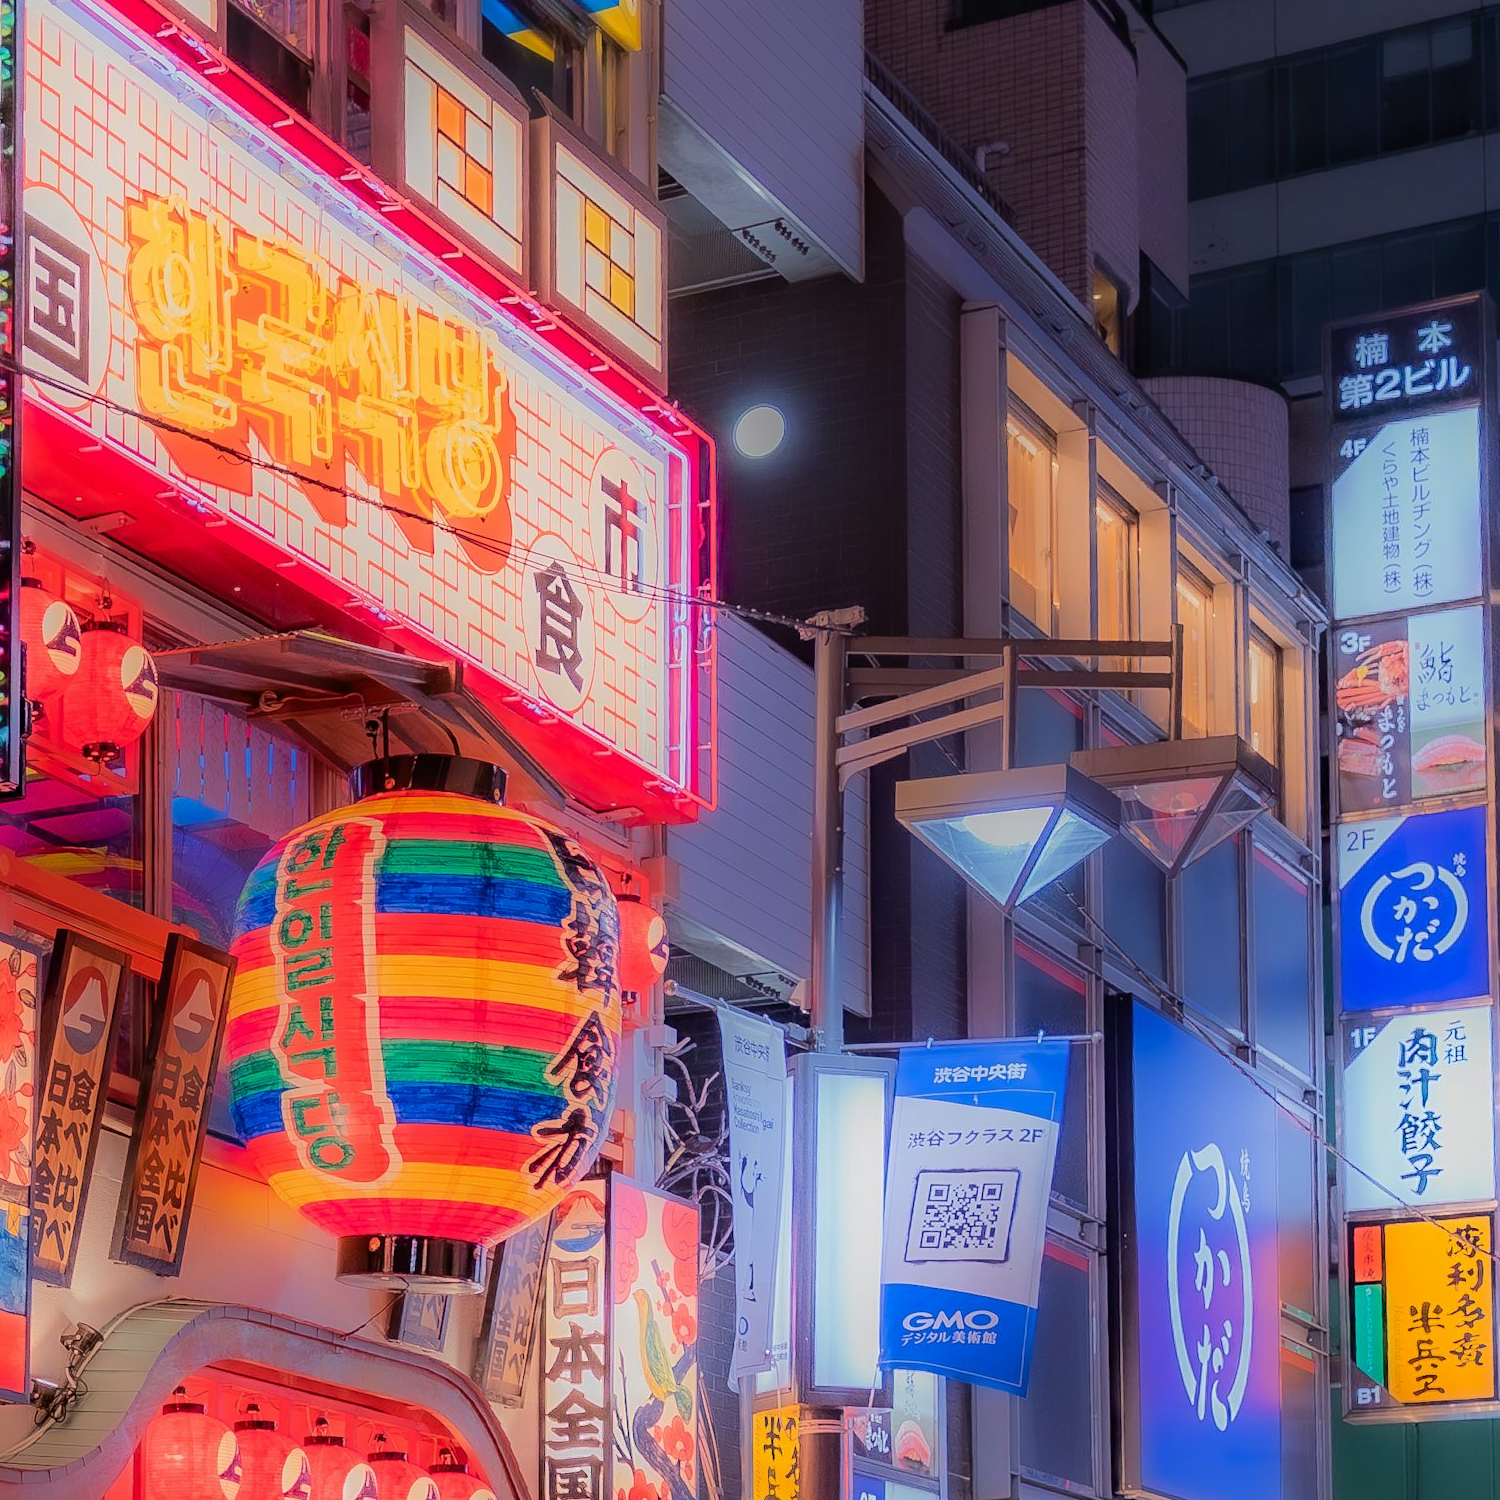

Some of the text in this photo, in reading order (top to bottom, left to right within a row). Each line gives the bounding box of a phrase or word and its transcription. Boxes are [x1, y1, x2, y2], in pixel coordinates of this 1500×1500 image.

[23, 210, 90, 386] 国
[127, 192, 512, 530] 한국식당
[1355, 320, 1453, 368] 楠本
[1338, 355, 1471, 410] 第2ビル
[1340, 436, 1367, 458] 4F
[600, 473, 648, 594] 市
[533, 561, 583, 693] 食
[1340, 632, 1371, 654] 3F
[1417, 641, 1454, 685] 鮨
[1416, 686, 1472, 711] まつもと
[1377, 705, 1397, 798] まつもと
[1346, 828, 1377, 853] 2F
[1390, 861, 1441, 964] つかだ
[279, 826, 355, 1170] 한일식당
[1350, 1027, 1377, 1050] 1F
[1443, 1019, 1469, 1064] 元祖
[933, 1062, 1028, 1084] 渋谷中央街
[908, 1126, 1045, 1149] 渋谷フクラス 2F
[1395, 1027, 1445, 1196] 肉汁餃子
[46, 1068, 97, 1261] 食べ比べ
[134, 1053, 183, 1244] 日本全国
[155, 1065, 205, 1254] 食べ比べ
[1238, 1148, 1251, 1213] 焼鳥
[1191, 1142, 1232, 1432] つかだ
[901, 1309, 999, 1332] GMO
[901, 1329, 997, 1348] デジタル美術館
[1356, 1386, 1382, 1405] B1
